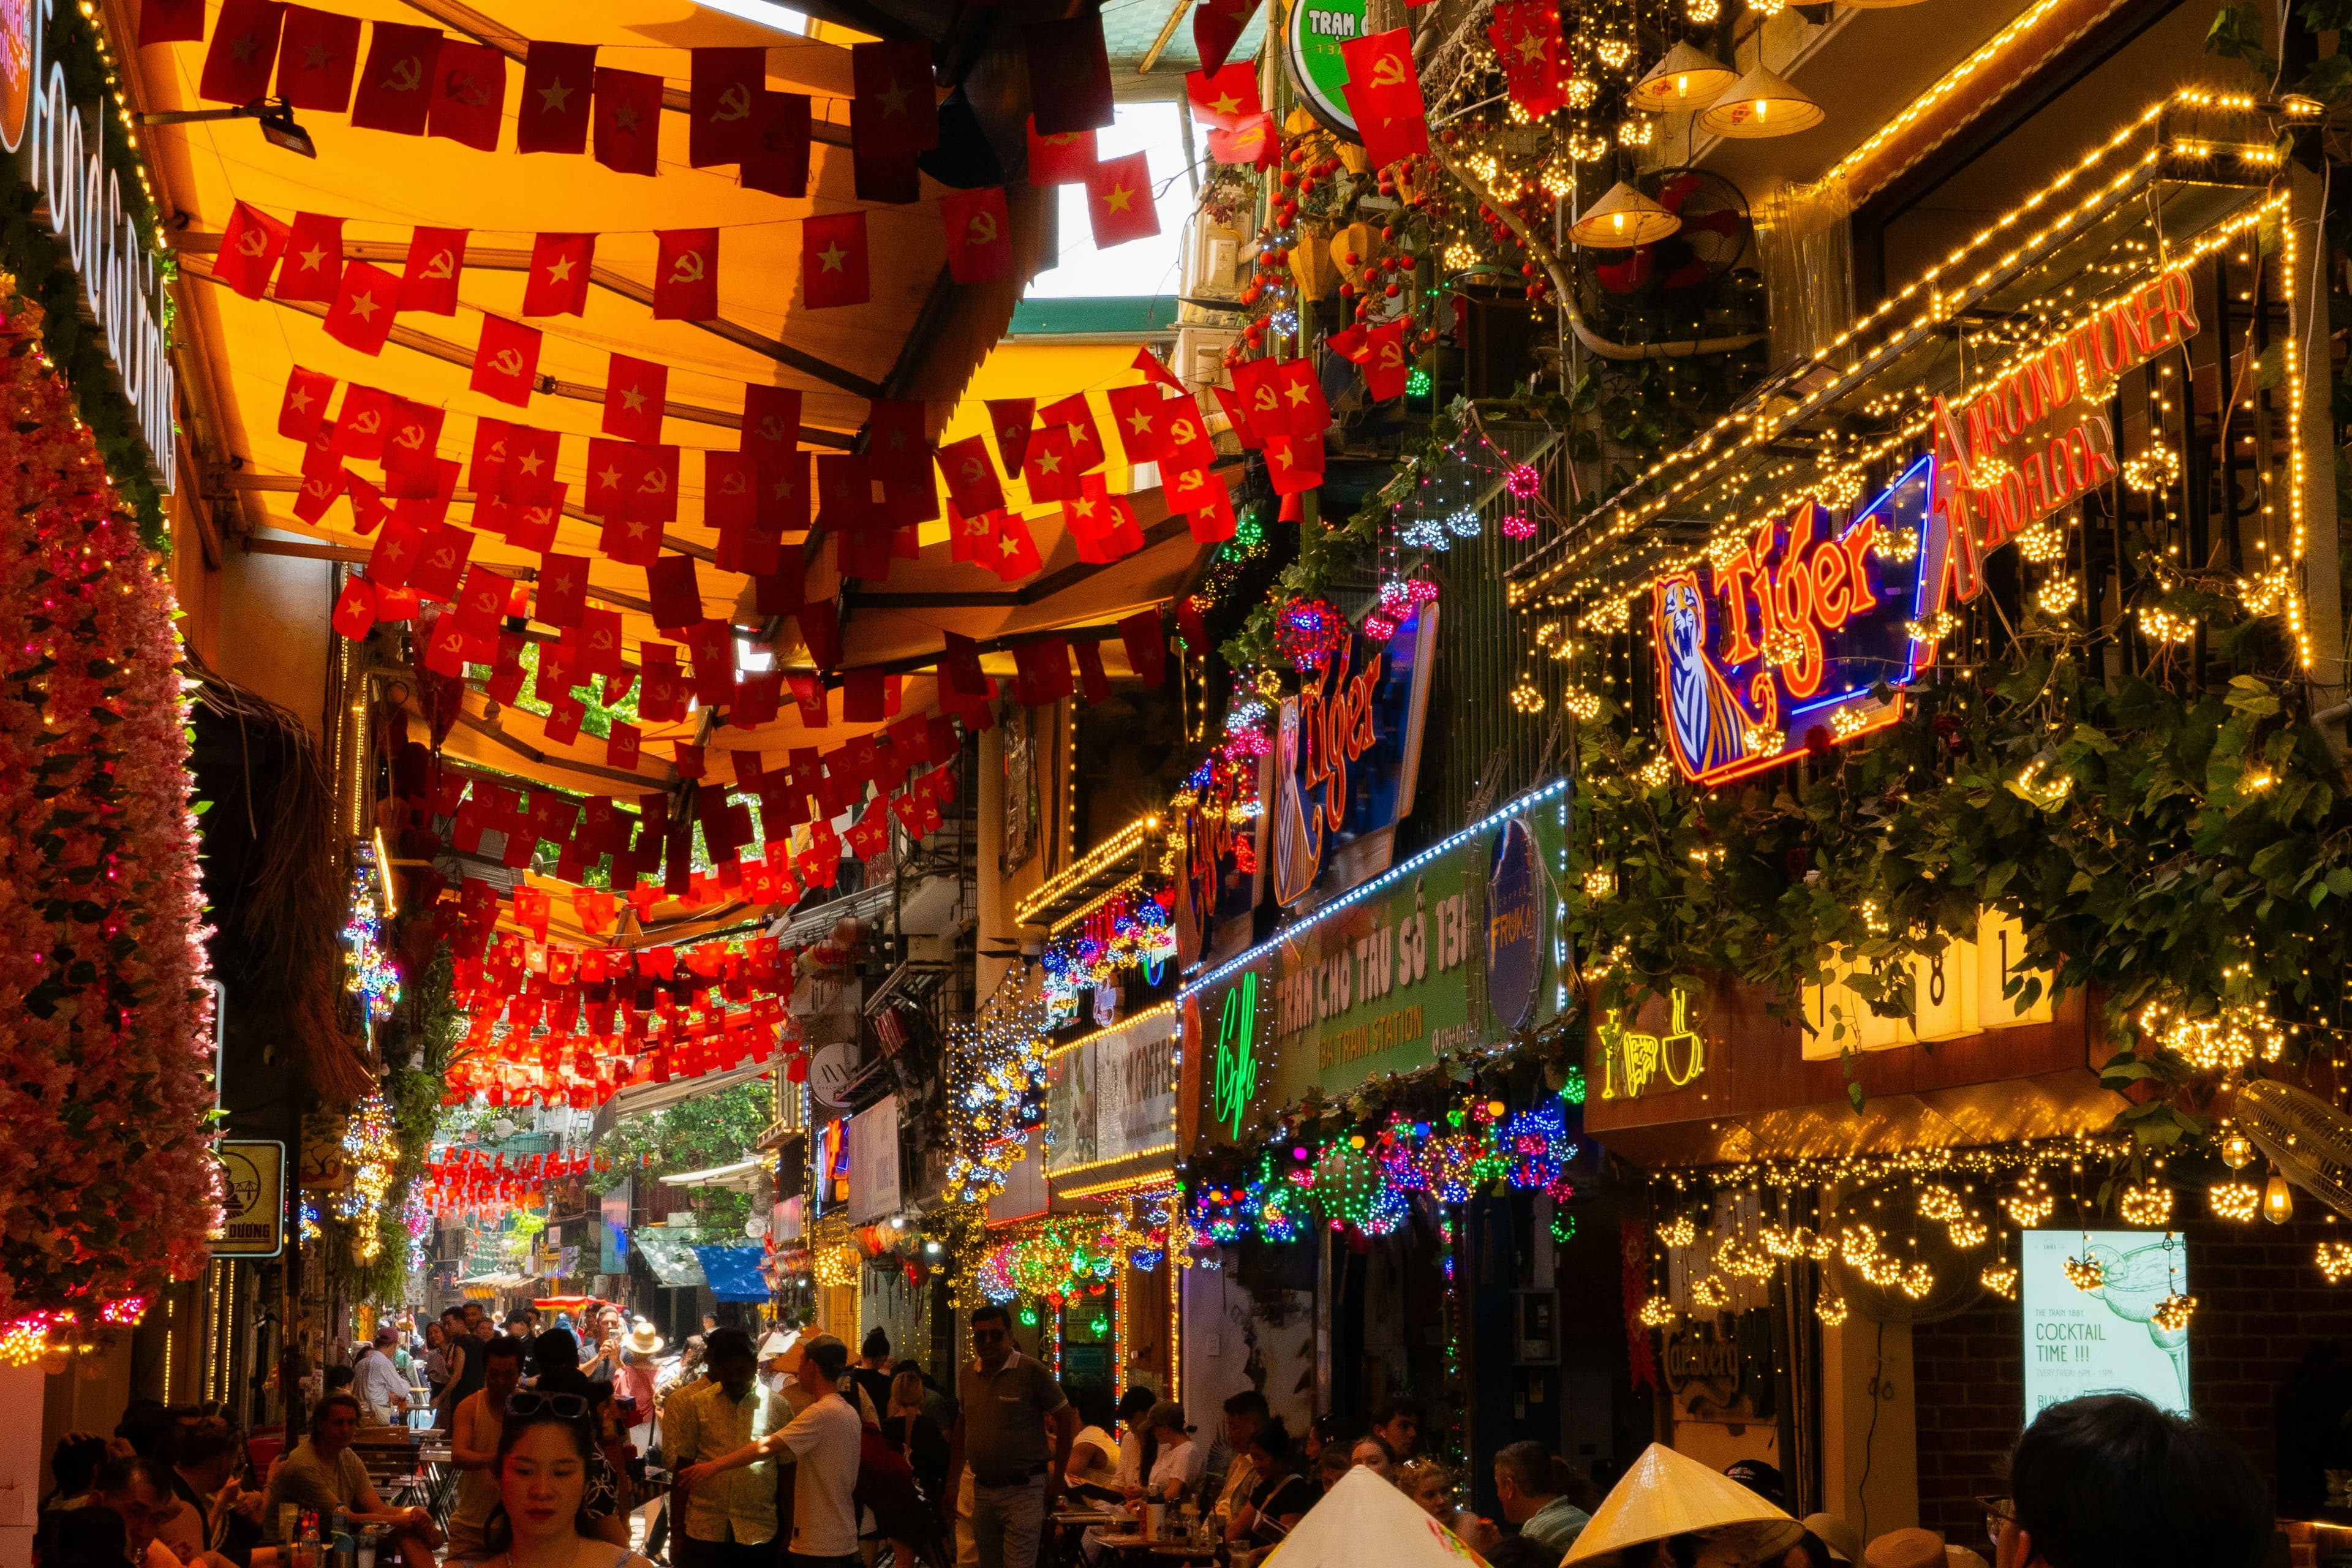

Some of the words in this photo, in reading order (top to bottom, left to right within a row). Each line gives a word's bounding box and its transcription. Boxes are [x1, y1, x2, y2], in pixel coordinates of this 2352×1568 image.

[1308, 10, 1355, 41] TRẠM
[32, 0, 103, 325] Food
[106, 168, 122, 375] &
[124, 211, 176, 497] Drinks
[1713, 500, 1877, 698] Tiger
[1300, 633, 1382, 832] Tiger
[1398, 874, 1427, 986] SỐ
[1337, 1023, 1370, 1064] TRAIN
[1372, 1005, 1423, 1054] STATION
[2035, 1345, 2068, 1362] TIME
[2075, 1345, 2089, 1362] !!!
[2036, 1323, 2106, 1340] COCKTAIL
